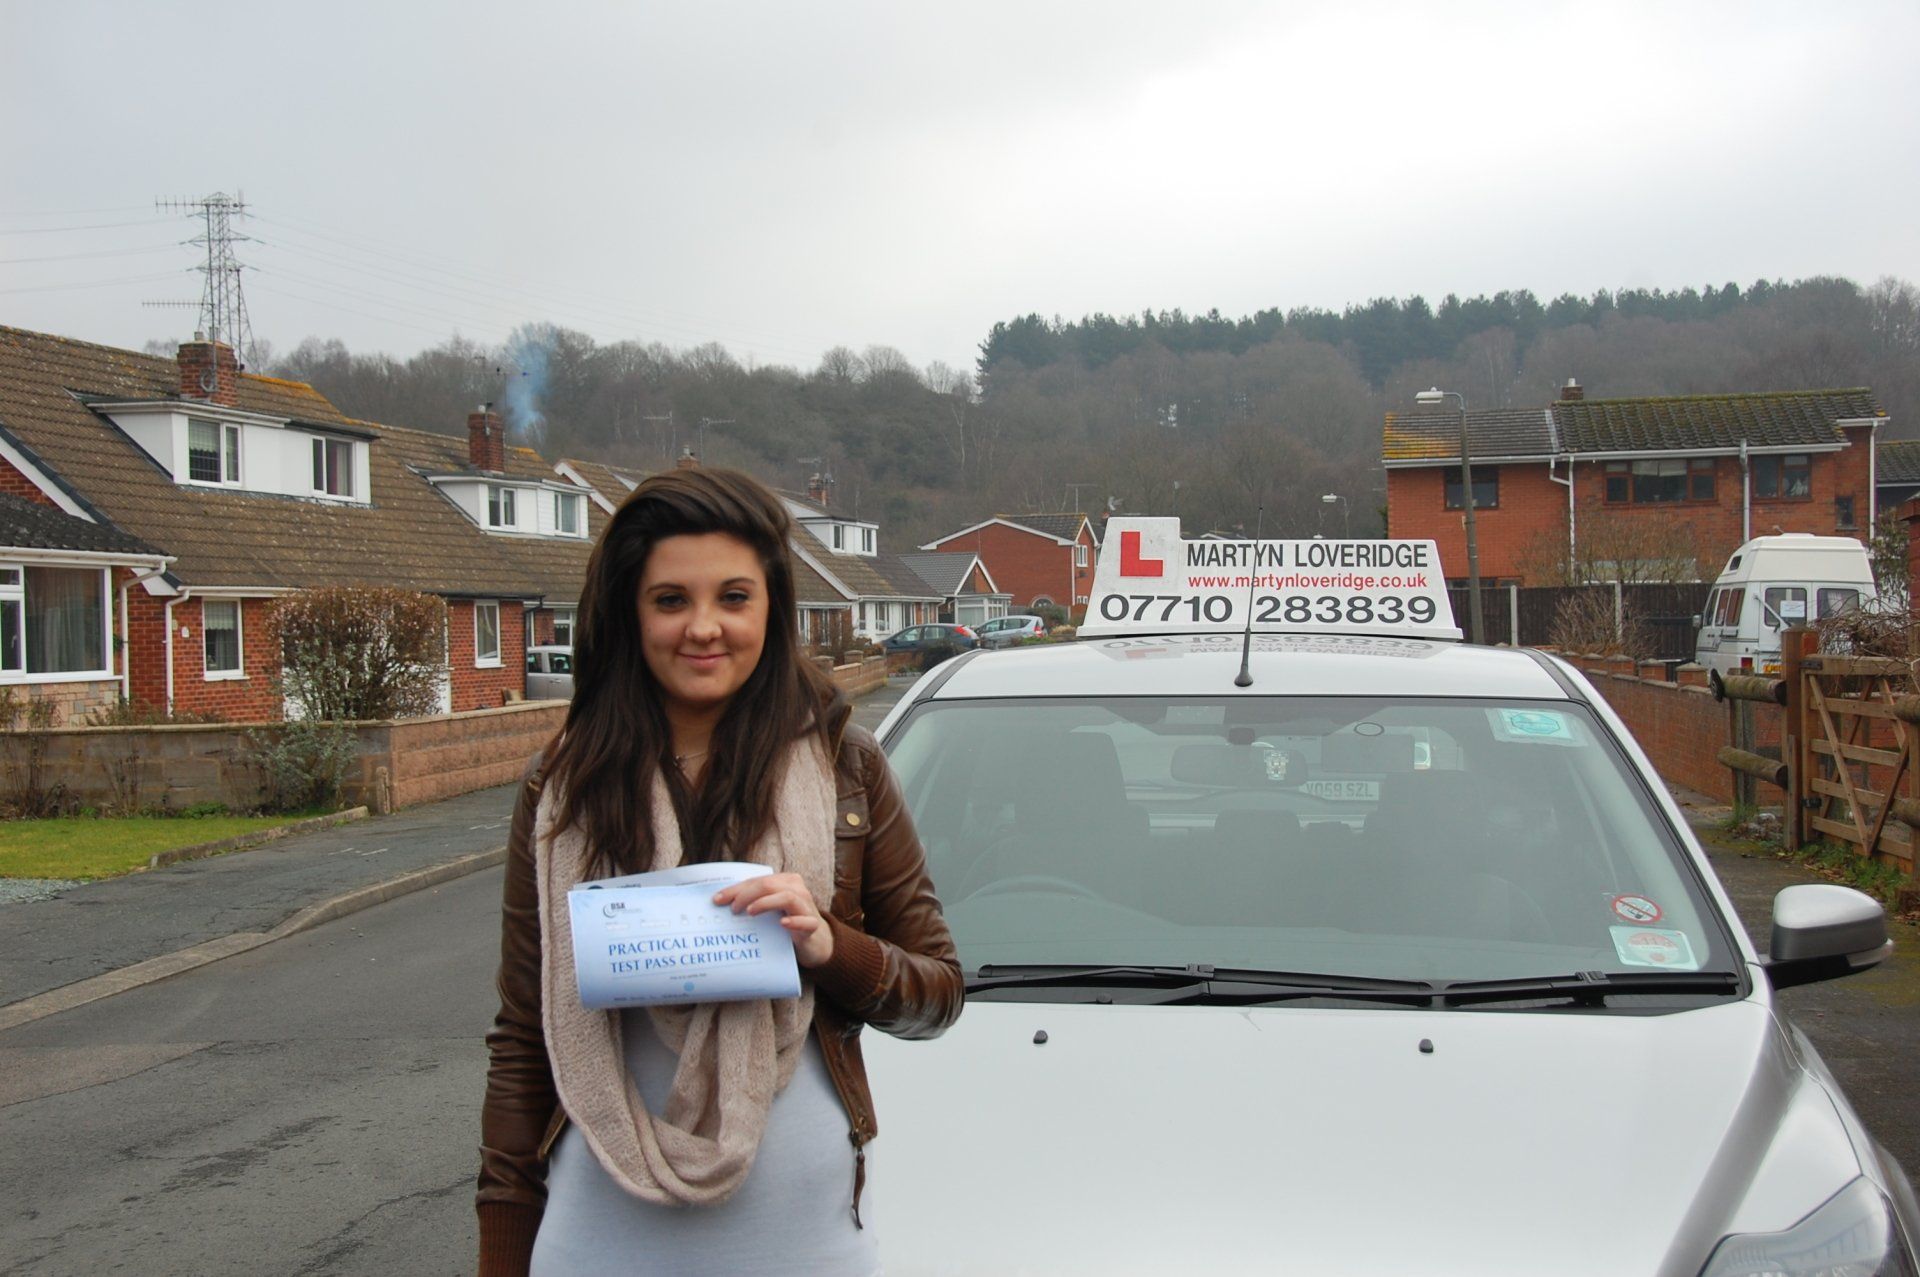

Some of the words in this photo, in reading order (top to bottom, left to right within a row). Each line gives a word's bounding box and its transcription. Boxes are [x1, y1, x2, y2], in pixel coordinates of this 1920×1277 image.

[1120, 531, 1163, 577] L
[1187, 543, 1284, 567] MARTYN
[1295, 544, 1428, 567] LOVERIDGE
[1188, 573, 1427, 591] www.martynloveridge.co.uk
[1100, 594, 1233, 622] 07710
[1255, 595, 1436, 623] 283839
[1346, 782, 1374, 798] SZL
[609, 937, 689, 956] PRACTICAL
[694, 933, 759, 950] DRIVING
[611, 959, 641, 973] TEST
[645, 955, 676, 970] PASS
[680, 949, 761, 966] CERTIFICATE
